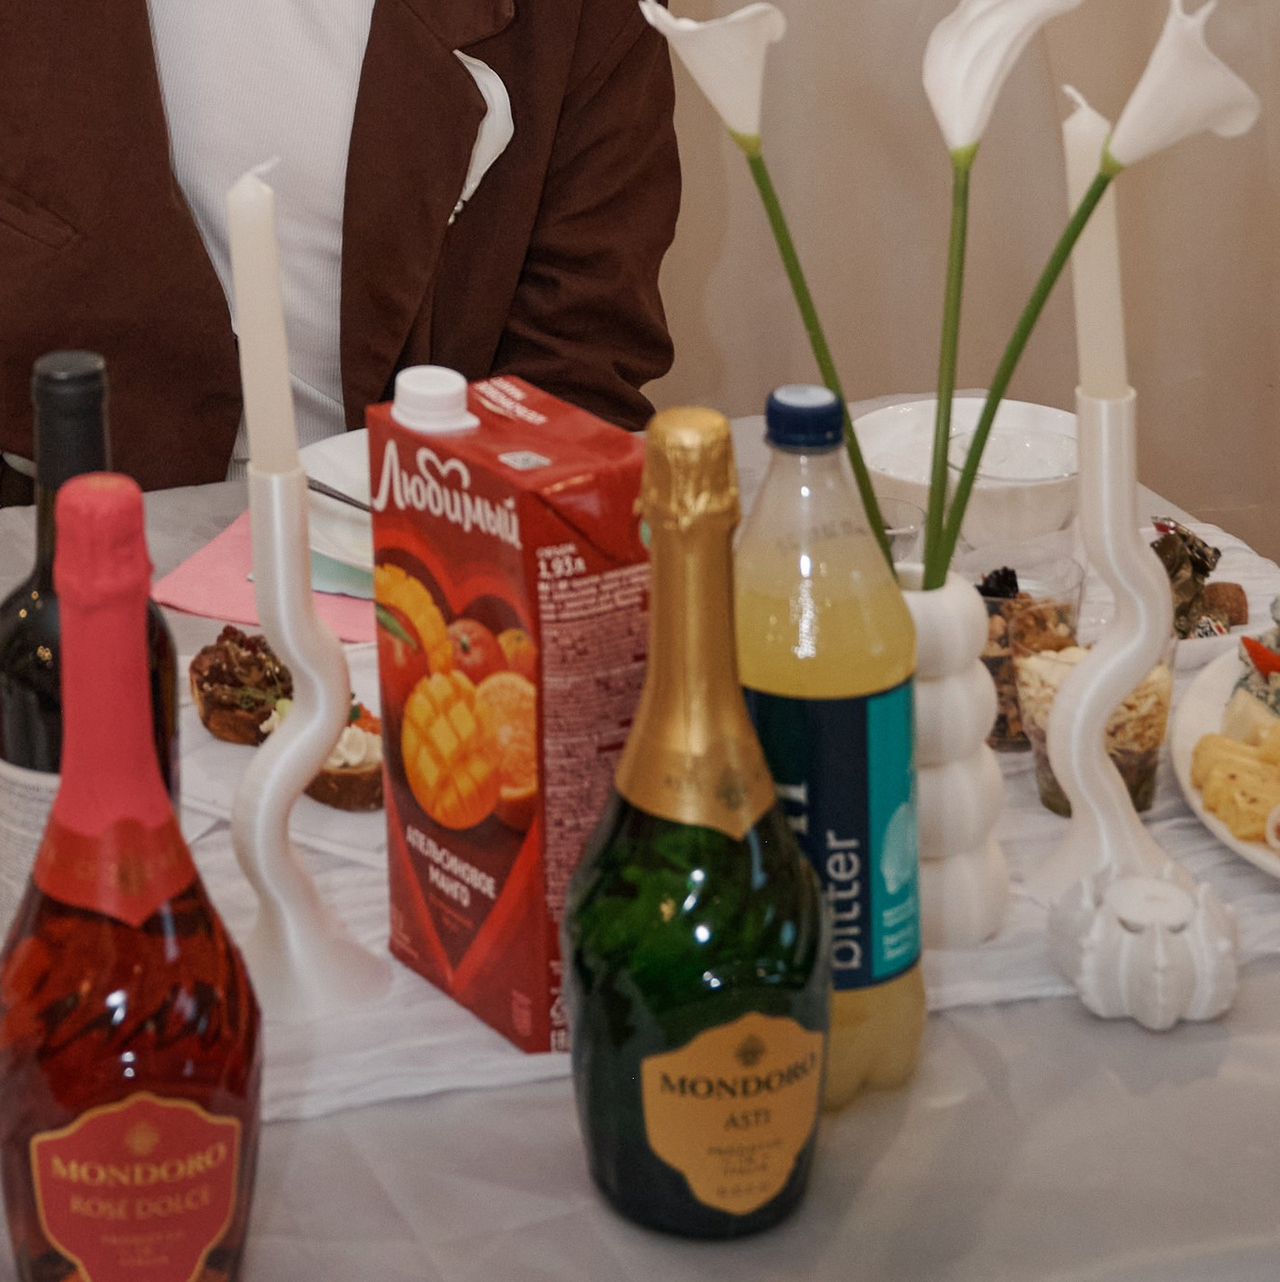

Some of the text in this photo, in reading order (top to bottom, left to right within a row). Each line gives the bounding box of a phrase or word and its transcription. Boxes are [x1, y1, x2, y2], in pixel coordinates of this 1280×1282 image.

[372, 438, 523, 550] Любимый
[660, 1051, 817, 1100] MONDORO
[722, 1106, 771, 1132] ASTI
[51, 1140, 227, 1187] MONDORO
